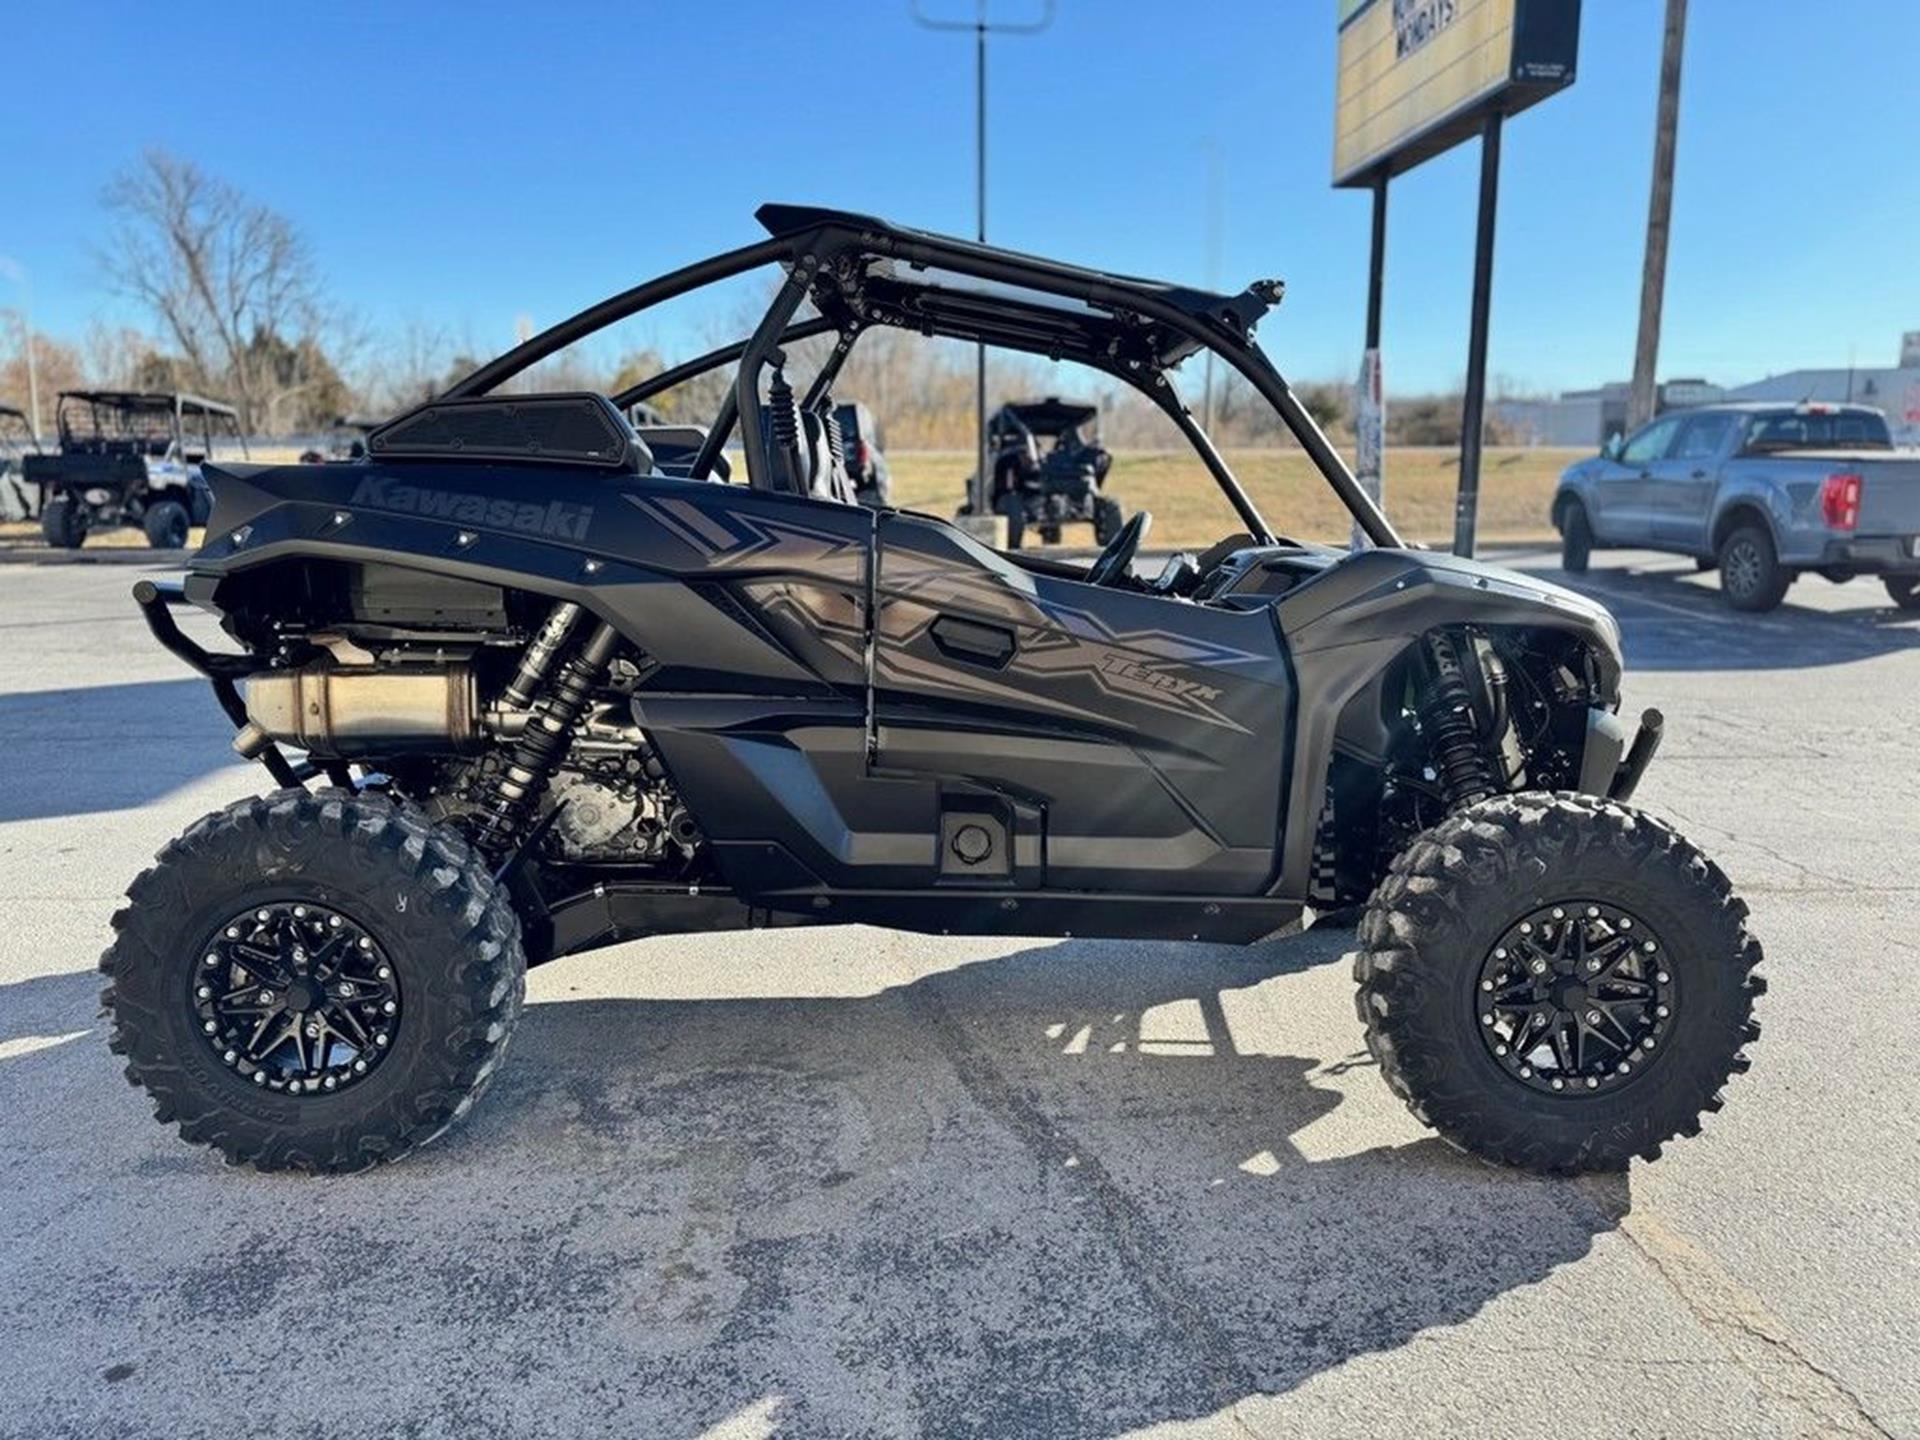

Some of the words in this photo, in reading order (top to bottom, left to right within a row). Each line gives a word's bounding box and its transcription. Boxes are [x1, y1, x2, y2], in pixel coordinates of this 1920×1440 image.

[1396, 1, 1455, 59] MONDAYS
[350, 475, 595, 541] Kawasaki
[1101, 653, 1224, 701] TERYX
